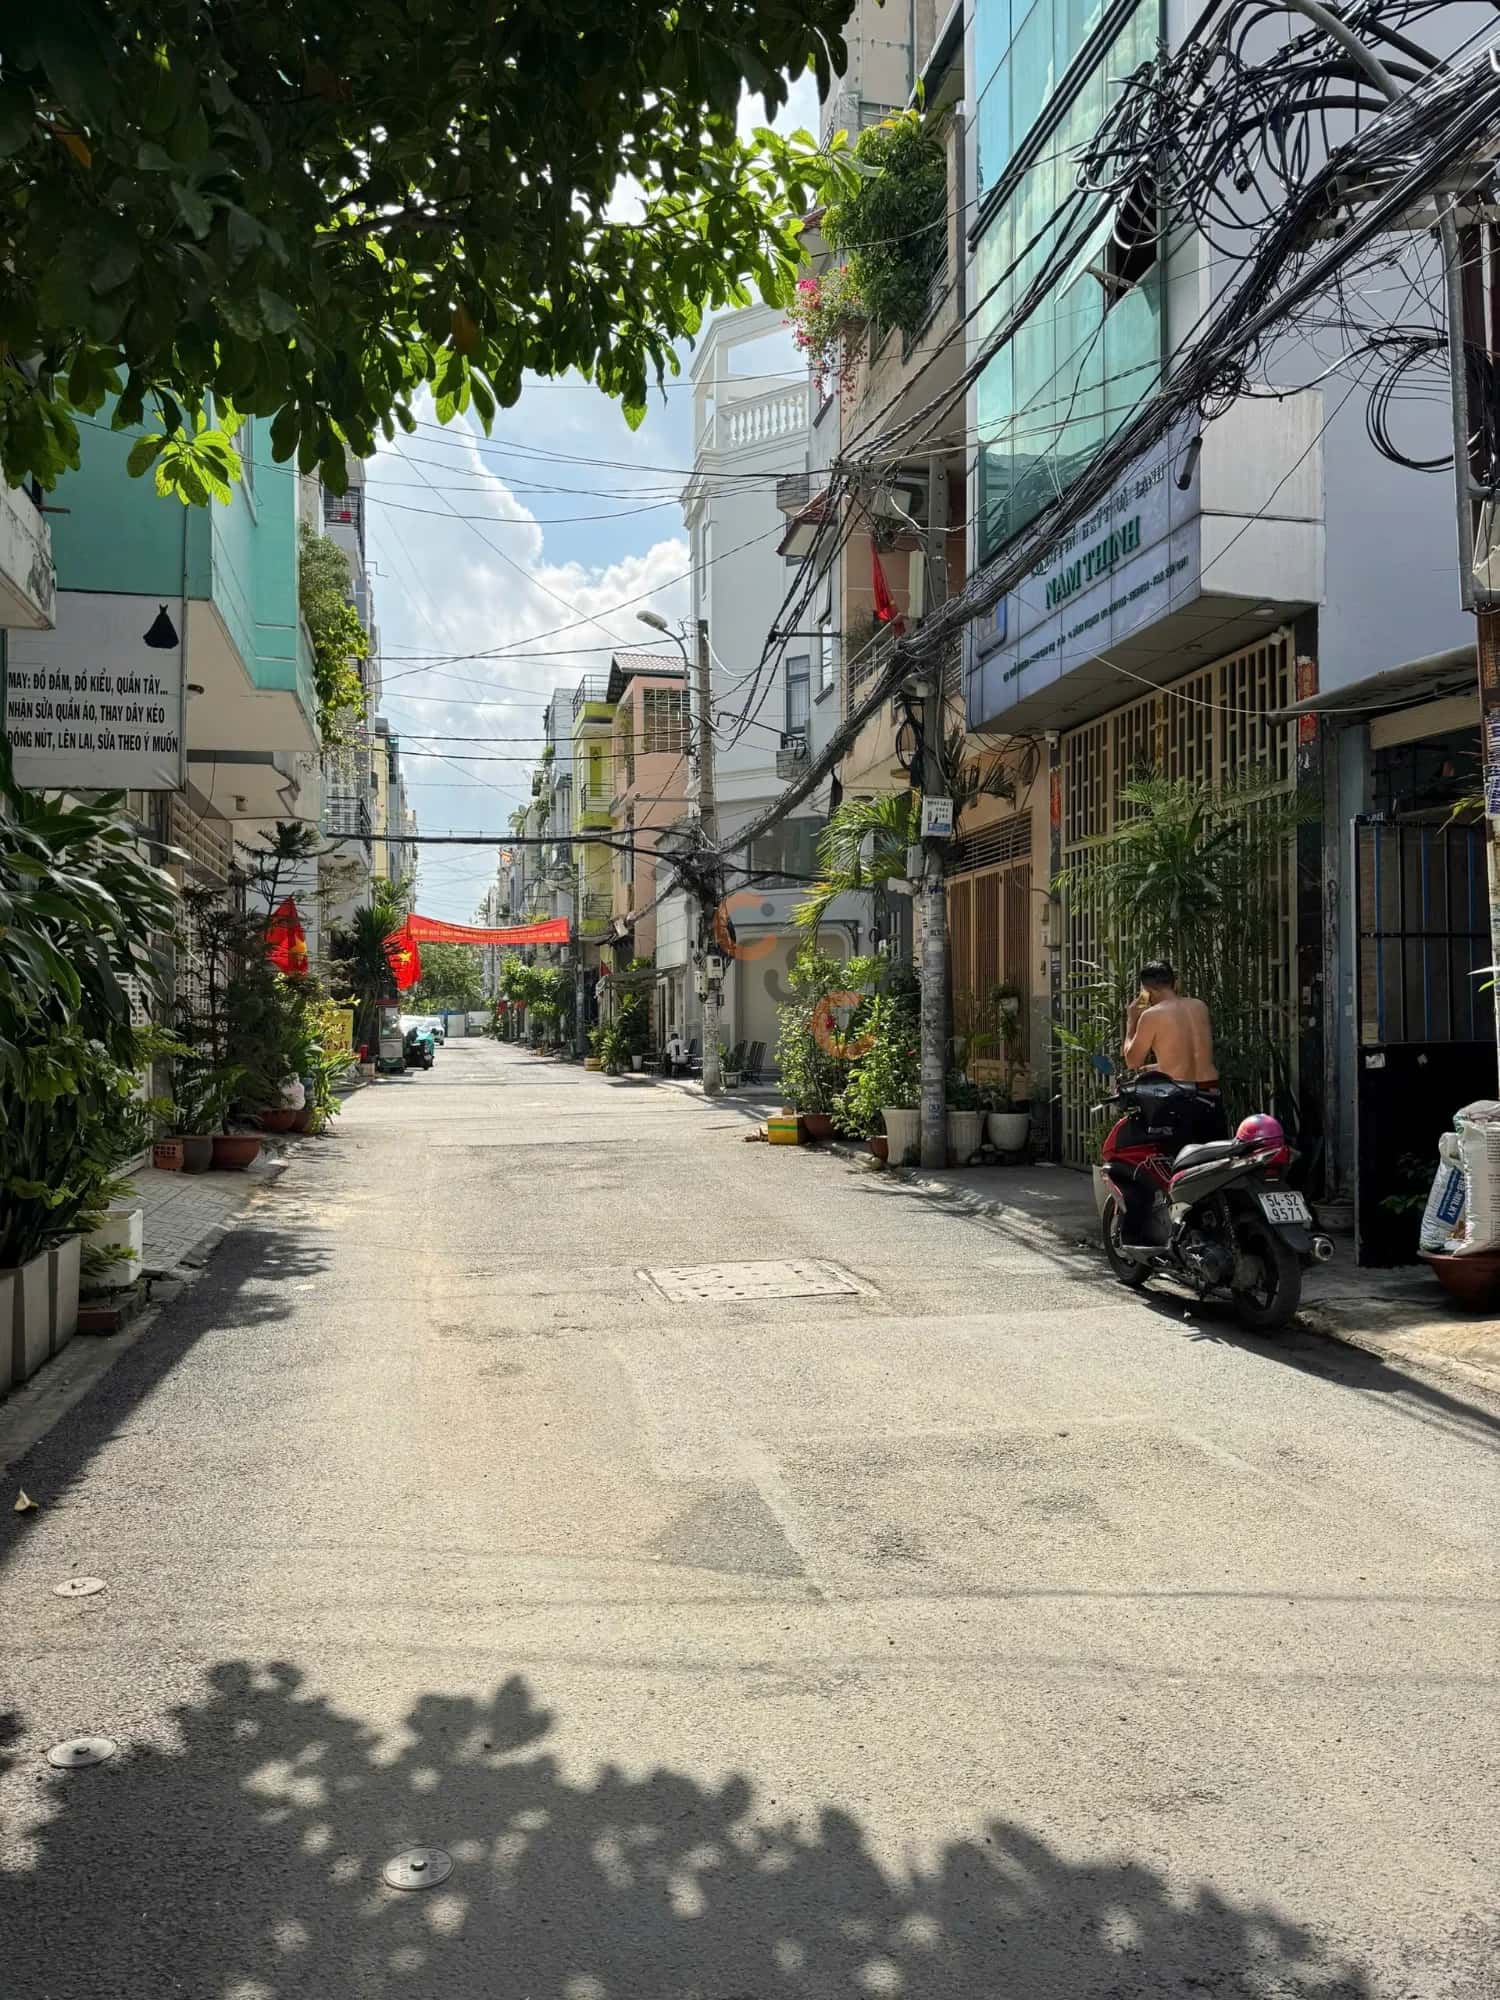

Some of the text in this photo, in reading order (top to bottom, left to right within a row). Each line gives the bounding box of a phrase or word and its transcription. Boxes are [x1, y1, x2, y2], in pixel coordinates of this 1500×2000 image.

[1045, 560, 1081, 611] NAM
[1083, 515, 1140, 582] THỊNH
[8, 672, 31, 689] MAY:
[143, 674, 169, 696] TÂY...
[8, 697, 33, 722] NHẬN
[35, 696, 53, 719] SỬA
[100, 705, 123, 722] THAY
[126, 702, 144, 722] DÂY
[146, 703, 165, 724] KÉO
[7, 726, 32, 747] ĐÓNG
[34, 727, 56, 752] NÚT,
[58, 728, 76, 749] LÊN
[78, 733, 95, 752] LAI,
[97, 727, 116, 750] SỬA
[118, 734, 142, 751] THEO
[152, 730, 179, 753] MUỐN
[1265, 1194, 1299, 1207] 54-S2
[1271, 1207, 1304, 1220] 9571
